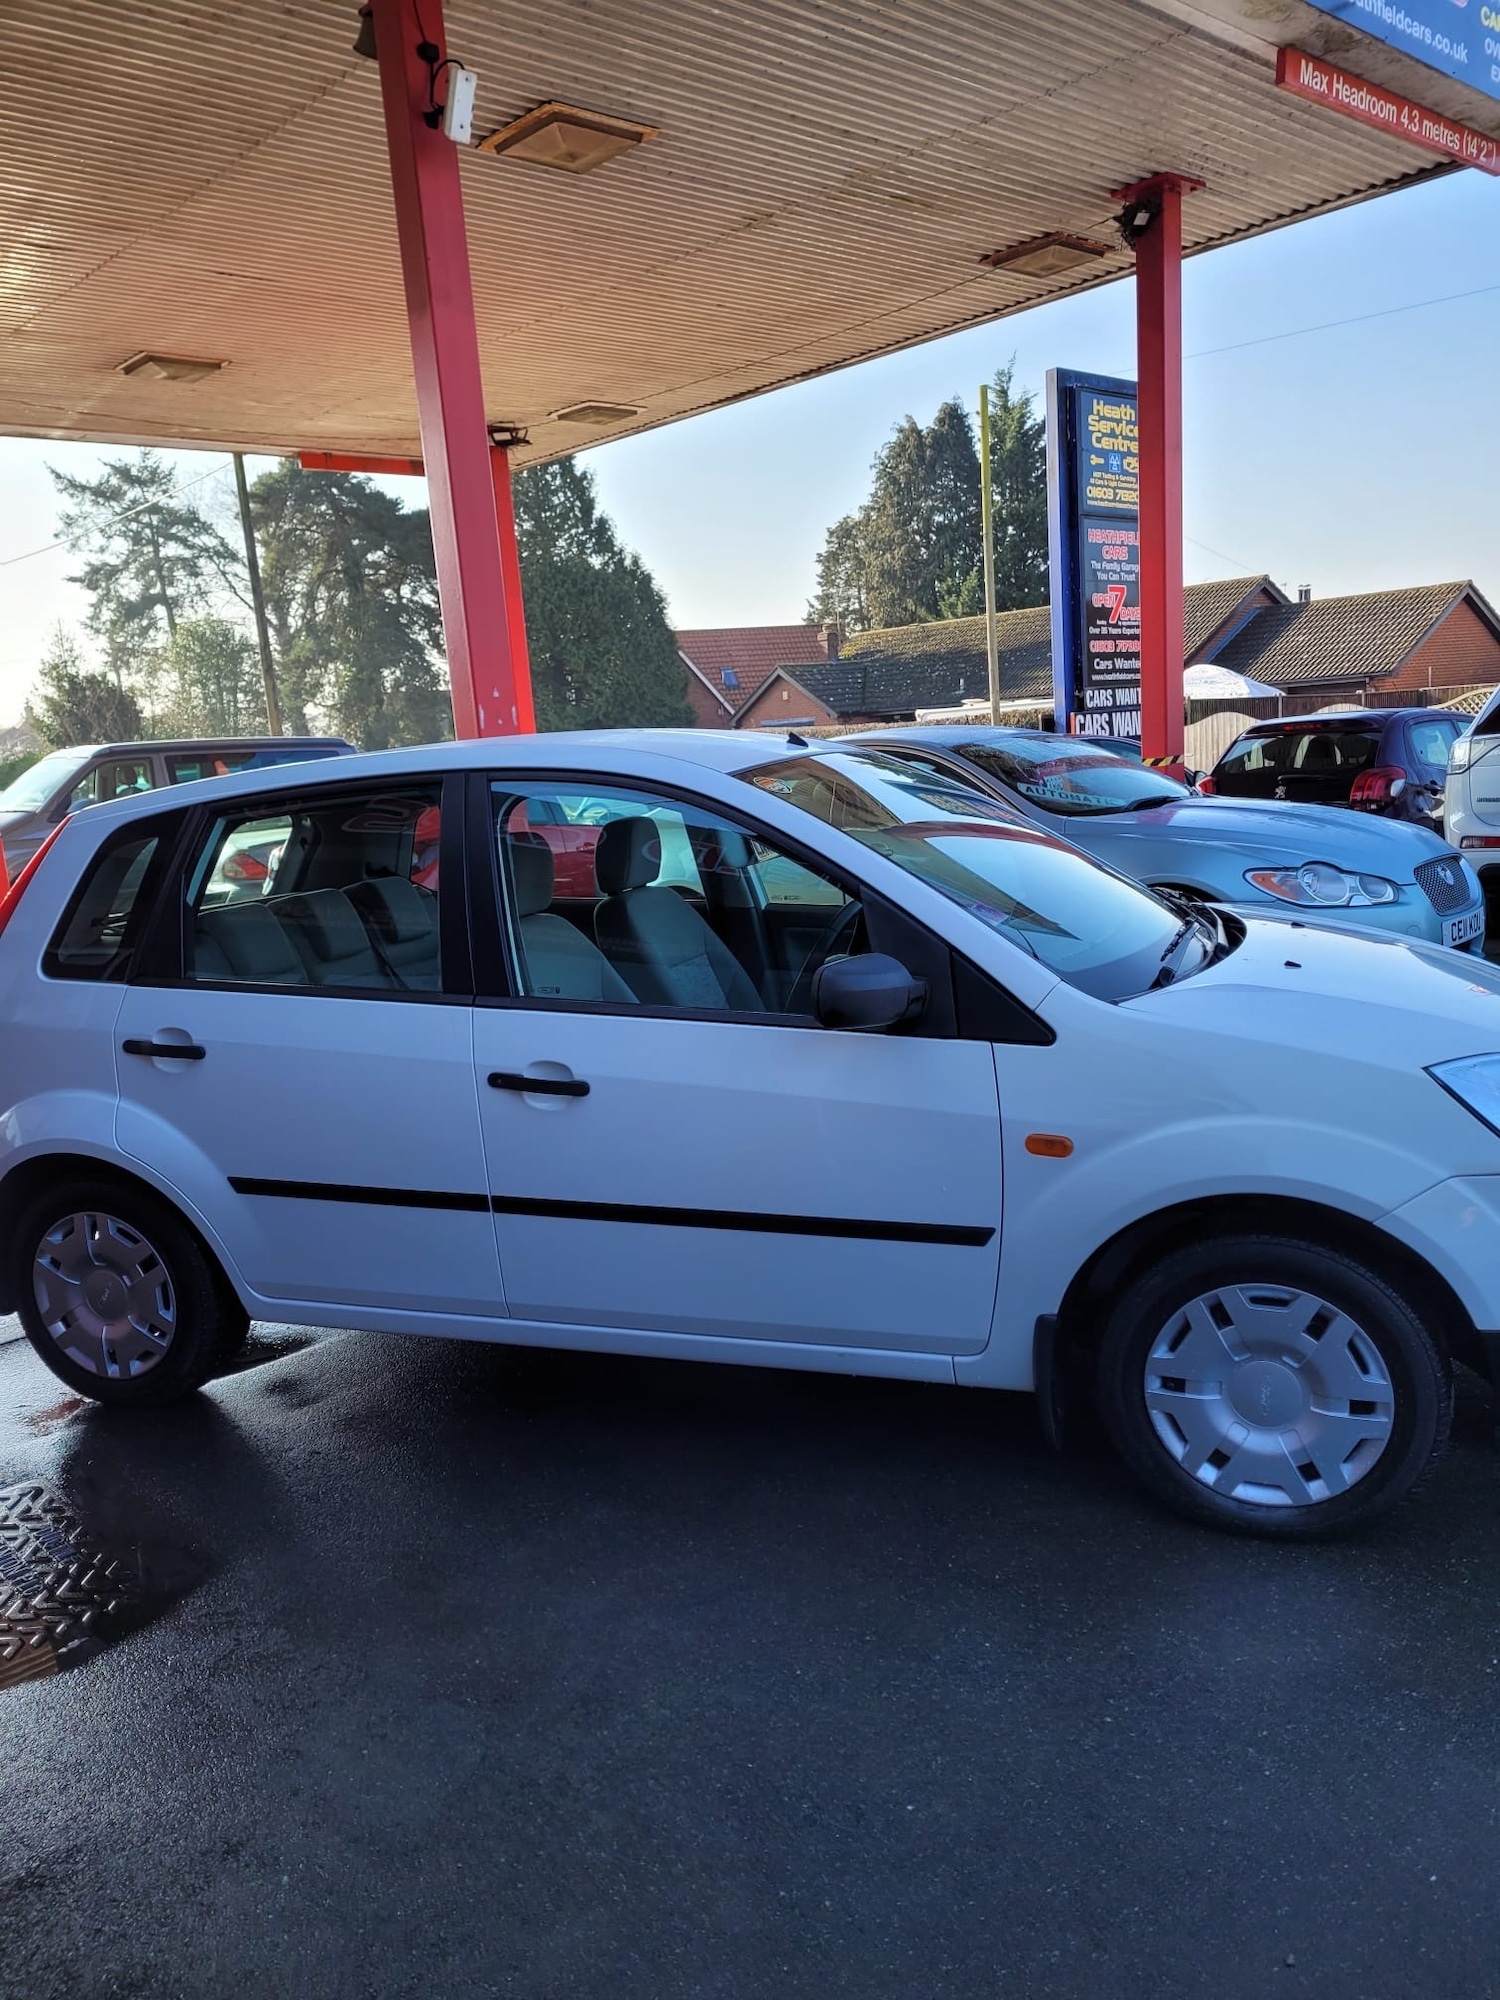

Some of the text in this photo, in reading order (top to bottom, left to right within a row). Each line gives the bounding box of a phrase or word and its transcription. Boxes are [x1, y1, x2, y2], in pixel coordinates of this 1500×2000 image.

[1300, 58, 1328, 94] Max
[1332, 73, 1397, 124] Headroom
[1400, 105, 1420, 133] 4.3
[1422, 120, 1460, 150] metres
[1093, 399, 1135, 421] Heath
[1086, 485, 1113, 500] 01603
[1088, 528, 1139, 545] HEATHFIEL
[1102, 545, 1128, 560] CARS
[1091, 560, 1139, 573] The Family Garag
[1097, 571, 1136, 581] You Can Trust
[1092, 593, 1116, 607] OPEN
[1107, 585, 1127, 623] 7
[1094, 657, 1140, 670] Cars Wante
[1086, 687, 1141, 708] CARS WANT
[1075, 711, 1141, 737] CARS WAN
